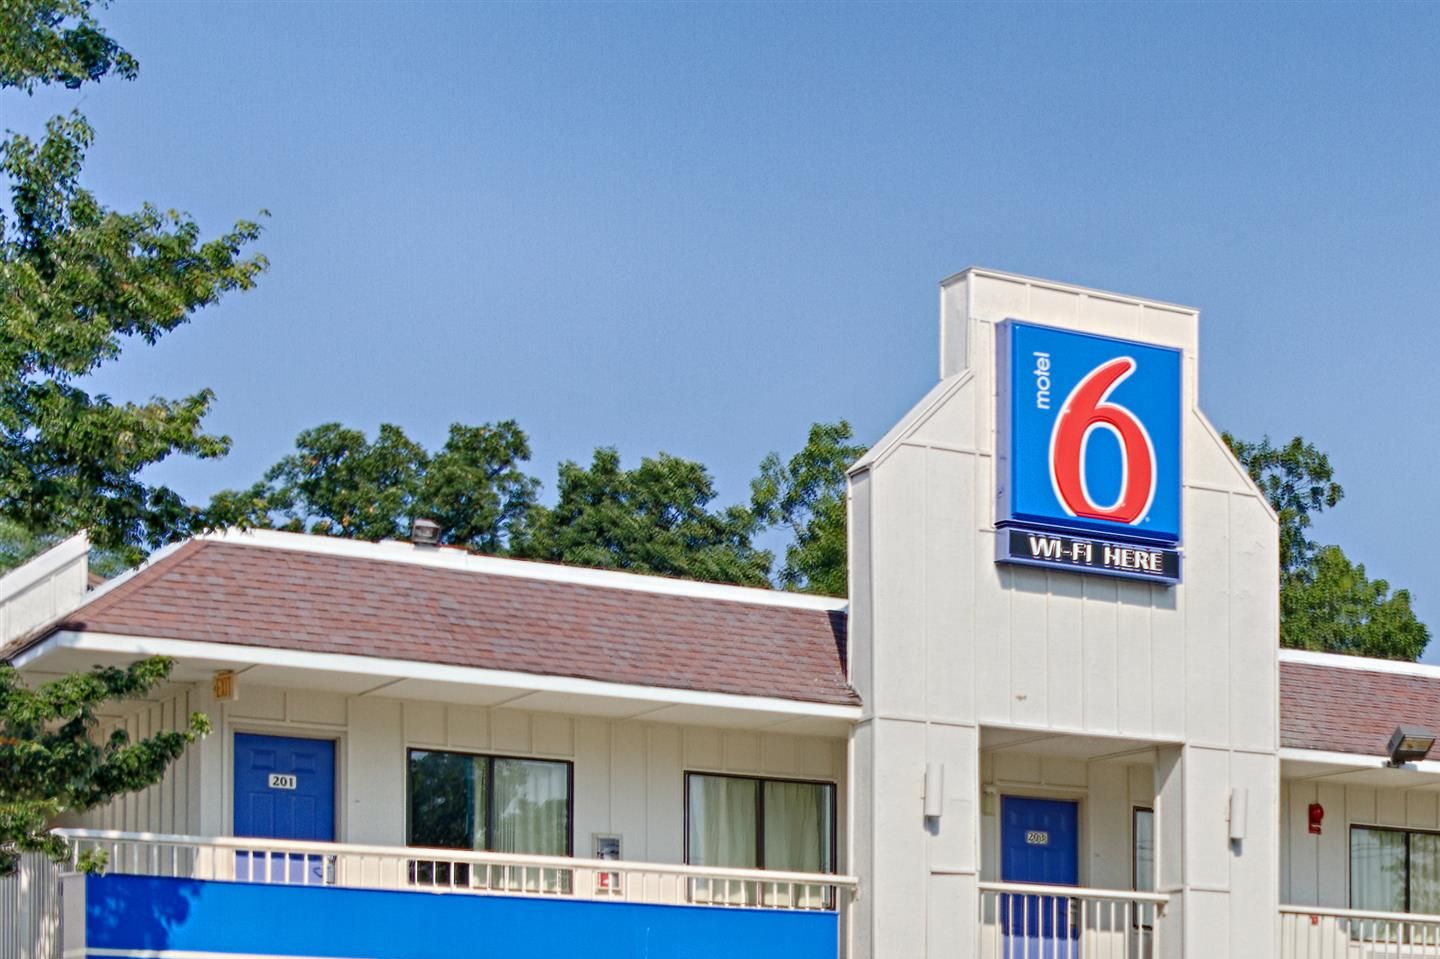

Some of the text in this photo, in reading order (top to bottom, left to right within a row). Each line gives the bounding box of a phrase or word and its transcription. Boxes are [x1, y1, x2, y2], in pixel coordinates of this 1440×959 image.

[1032, 351, 1051, 410] motel
[1048, 355, 1158, 526] 6
[1029, 535, 1164, 574] WI-FI HERE
[272, 775, 294, 787] 201
